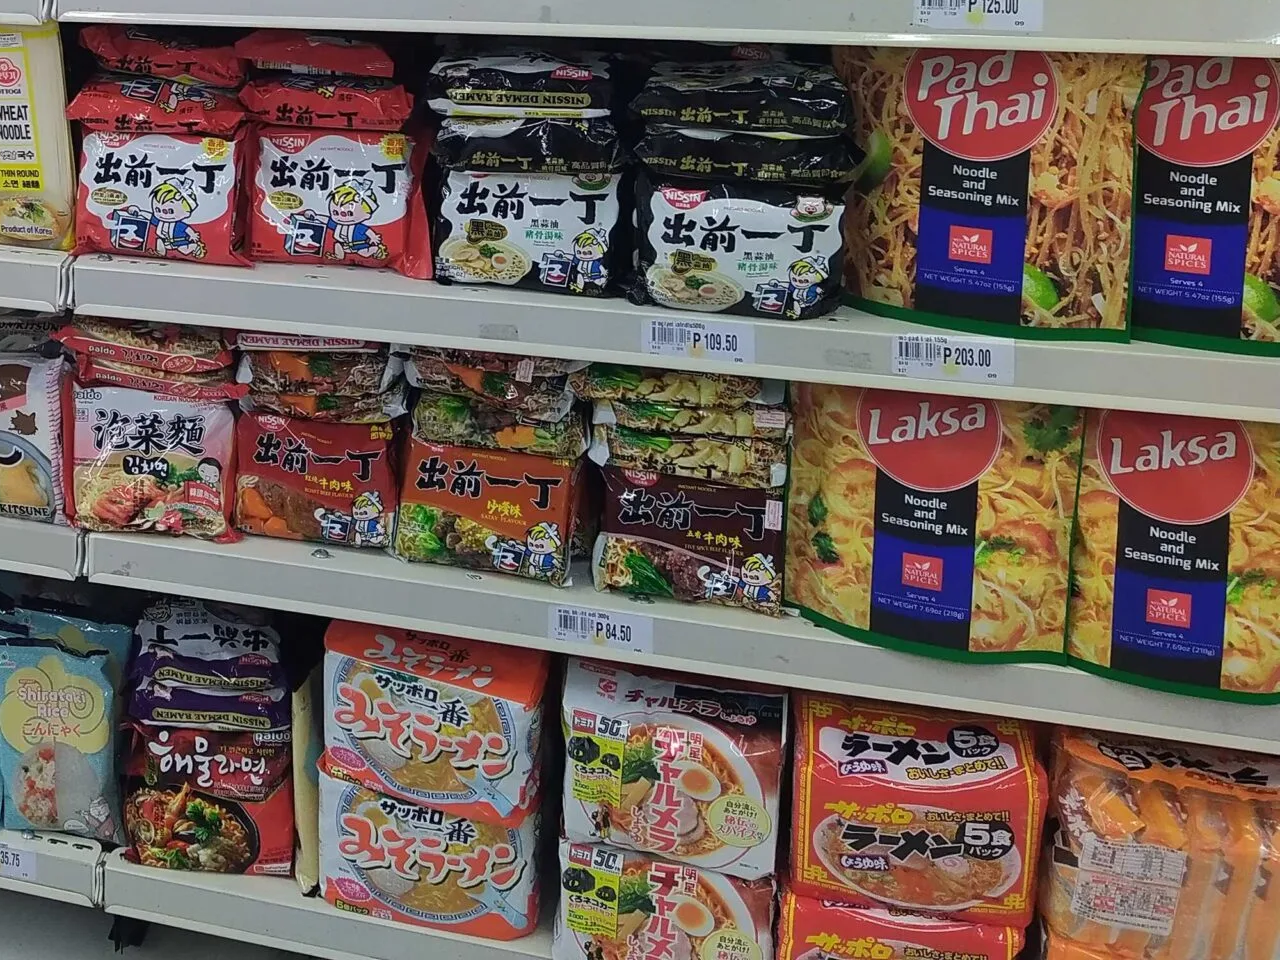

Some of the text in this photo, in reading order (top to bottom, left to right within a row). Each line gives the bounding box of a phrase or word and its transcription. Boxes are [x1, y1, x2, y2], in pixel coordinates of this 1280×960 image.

[554, 68, 589, 78] NISSIN
[917, 51, 1016, 102] Pad
[934, 73, 1049, 140] Thai
[1149, 74, 1271, 147] Thai
[94, 153, 227, 194] 出前一丁
[270, 154, 407, 194] 出前一丁
[953, 164, 998, 180] Noodle
[962, 178, 986, 189] and
[1169, 171, 1218, 186] Noodle
[664, 190, 702, 203] NISSIN
[928, 186, 1020, 207] Seasoning Mix
[1180, 185, 1205, 197] and
[1143, 194, 1241, 214] Seasoning Mix
[661, 212, 828, 254] 出前一丁
[868, 401, 987, 446] Laksa
[252, 432, 381, 482] 出前一丁
[1110, 429, 1238, 476] Laksa
[417, 456, 563, 509] 出前一丁
[0, 504, 50, 517] KITSUNE
[904, 493, 947, 510] Noodle
[881, 512, 968, 536] Seasoning Mix
[914, 508, 937, 520] and
[1149, 526, 1197, 544] Noodle
[1124, 547, 1221, 572] Seasoning Mix
[1160, 542, 1185, 554] and
[17, 685, 86, 706] Shirataki
[36, 703, 69, 719] Rice
[334, 684, 514, 778] みそラーメン
[840, 733, 952, 766] ラーメン
[339, 813, 526, 889] みそラーメン
[840, 823, 965, 861] ラーメン
